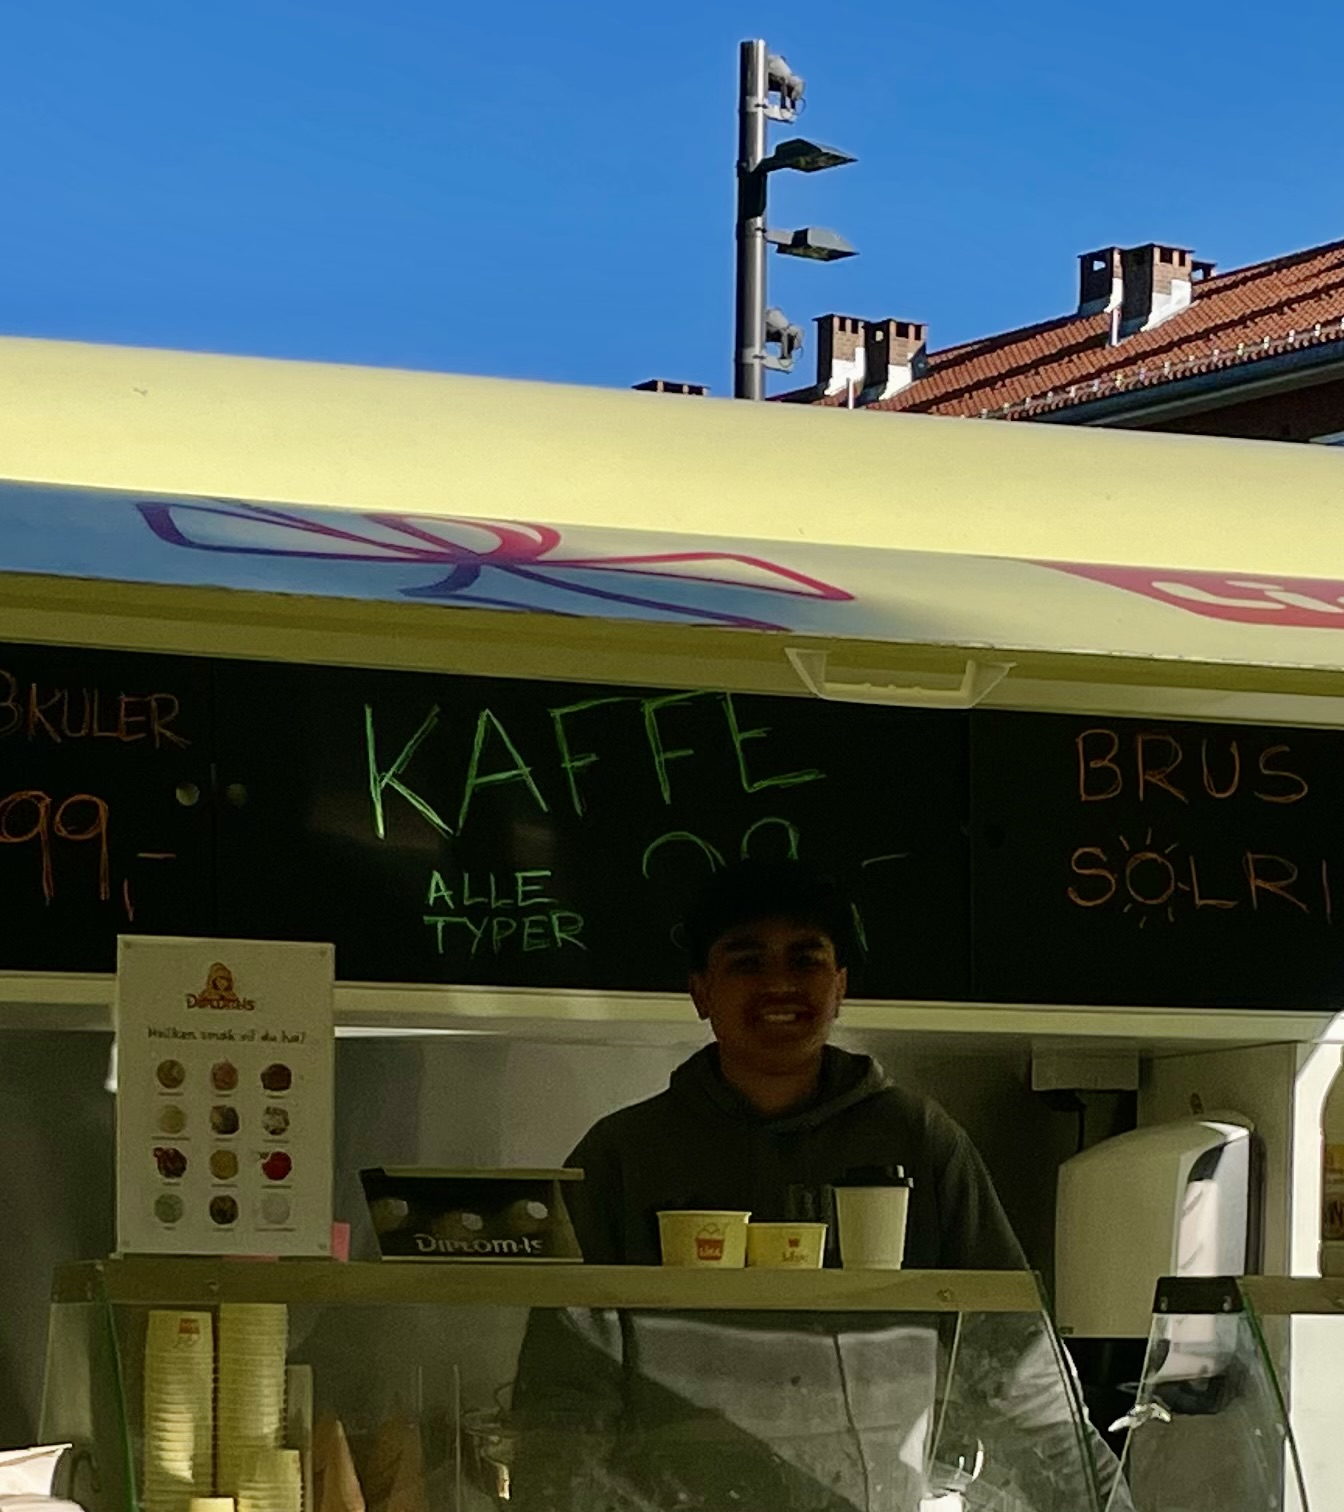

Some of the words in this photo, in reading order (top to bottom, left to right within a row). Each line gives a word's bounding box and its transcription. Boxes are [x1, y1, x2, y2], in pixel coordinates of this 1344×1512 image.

[363, 687, 828, 840] KAFFE
[1075, 728, 1310, 804] BRUS
[428, 869, 553, 910] ALLE
[422, 913, 588, 955] TYPER
